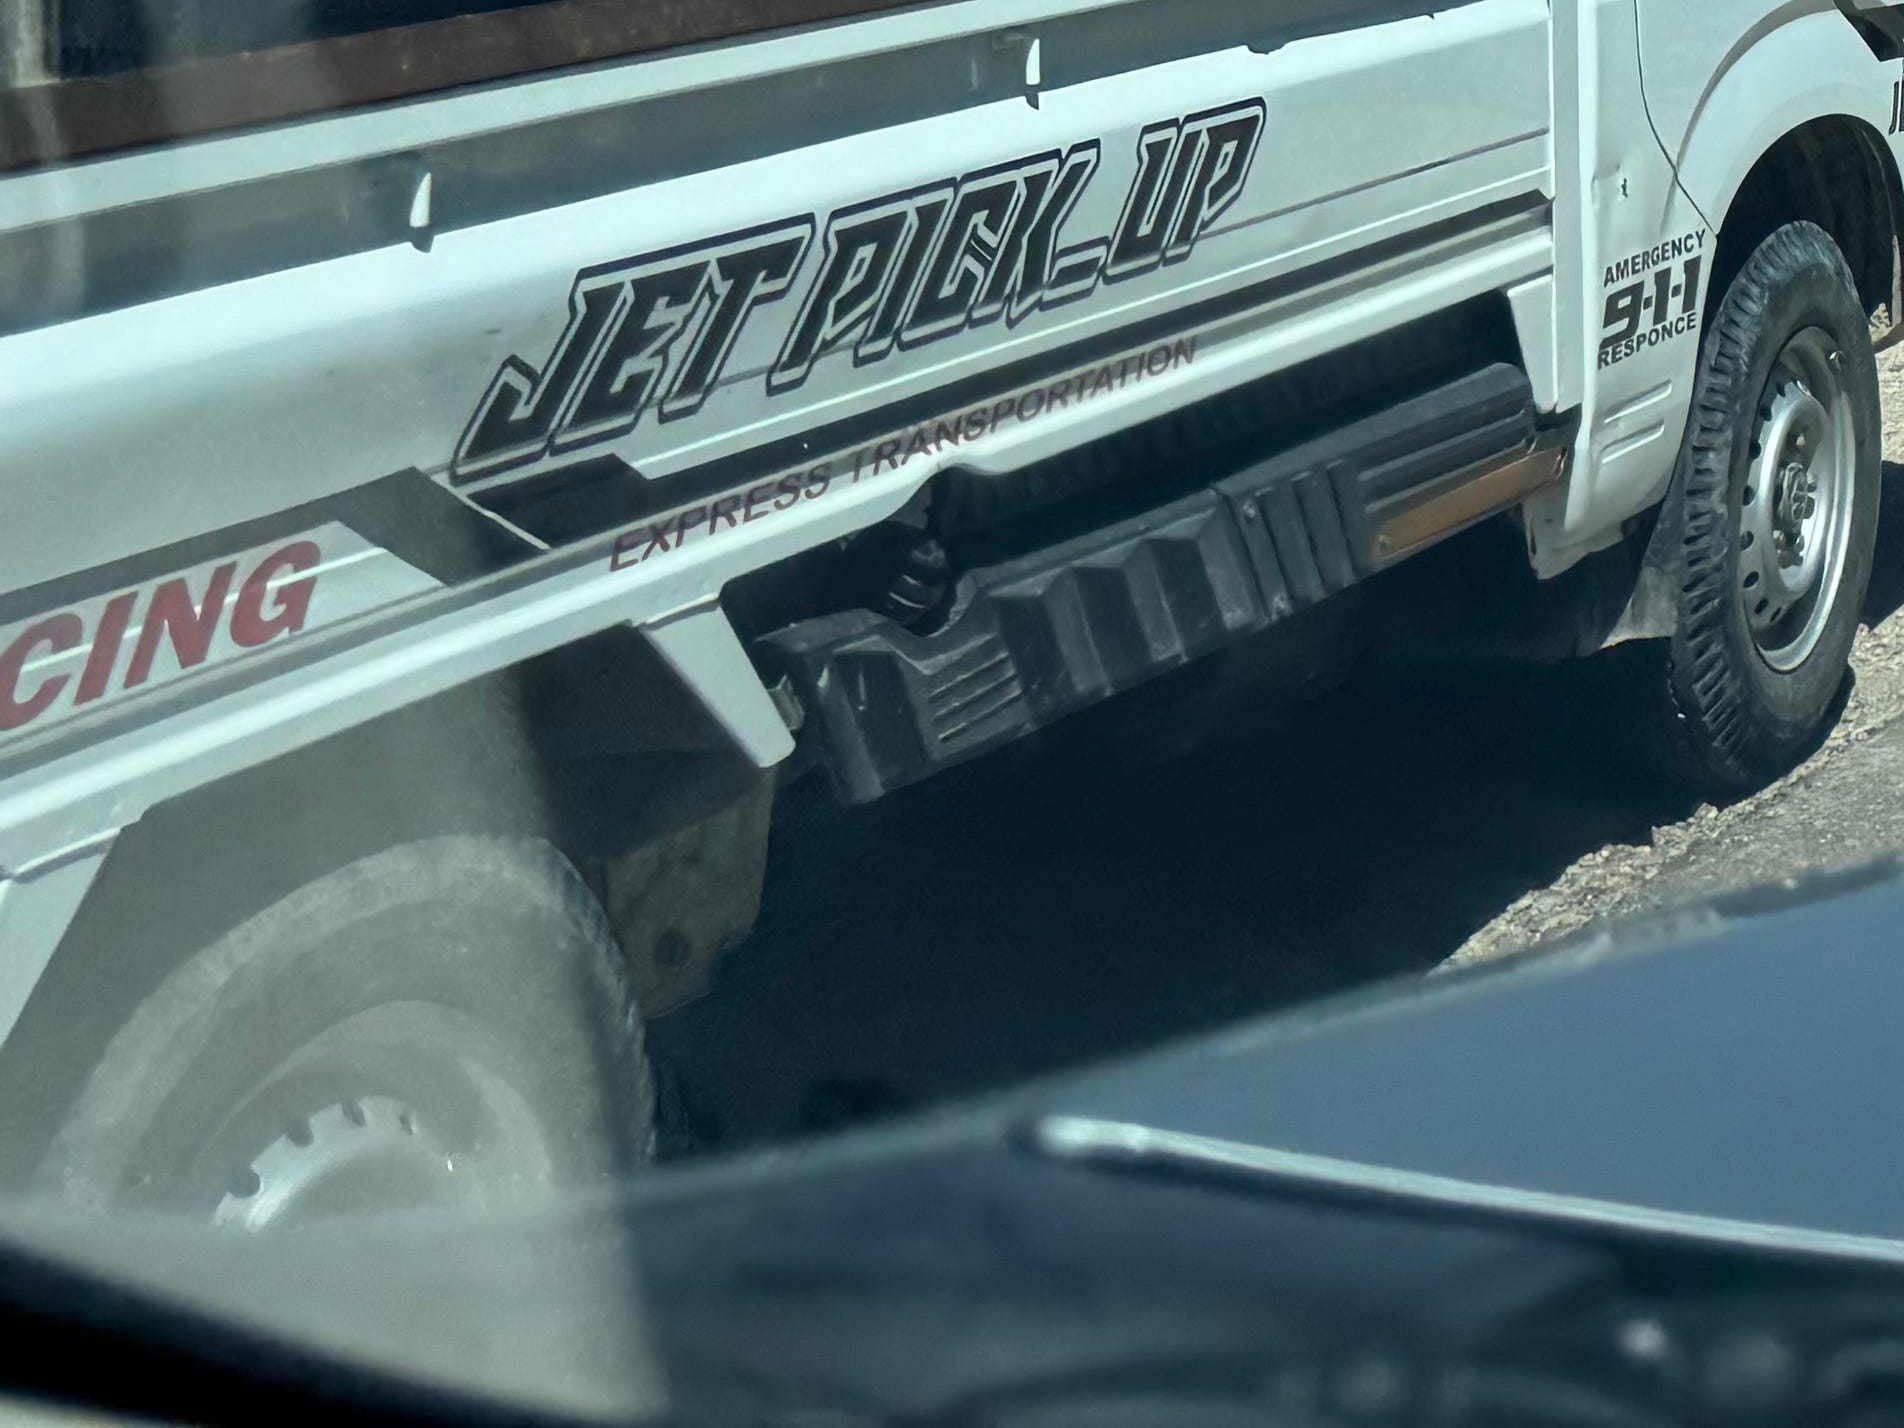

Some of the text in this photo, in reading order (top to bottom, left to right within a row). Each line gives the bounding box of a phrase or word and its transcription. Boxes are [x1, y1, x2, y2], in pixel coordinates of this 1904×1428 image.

[452, 96, 1267, 485] JET PICK UP
[1597, 312, 1697, 371] RESPONCE
[1603, 228, 1706, 289] AMERGENCY
[607, 335, 1199, 572] EXPRESS TRANSPORTATION
[0, 540, 322, 731] CING
